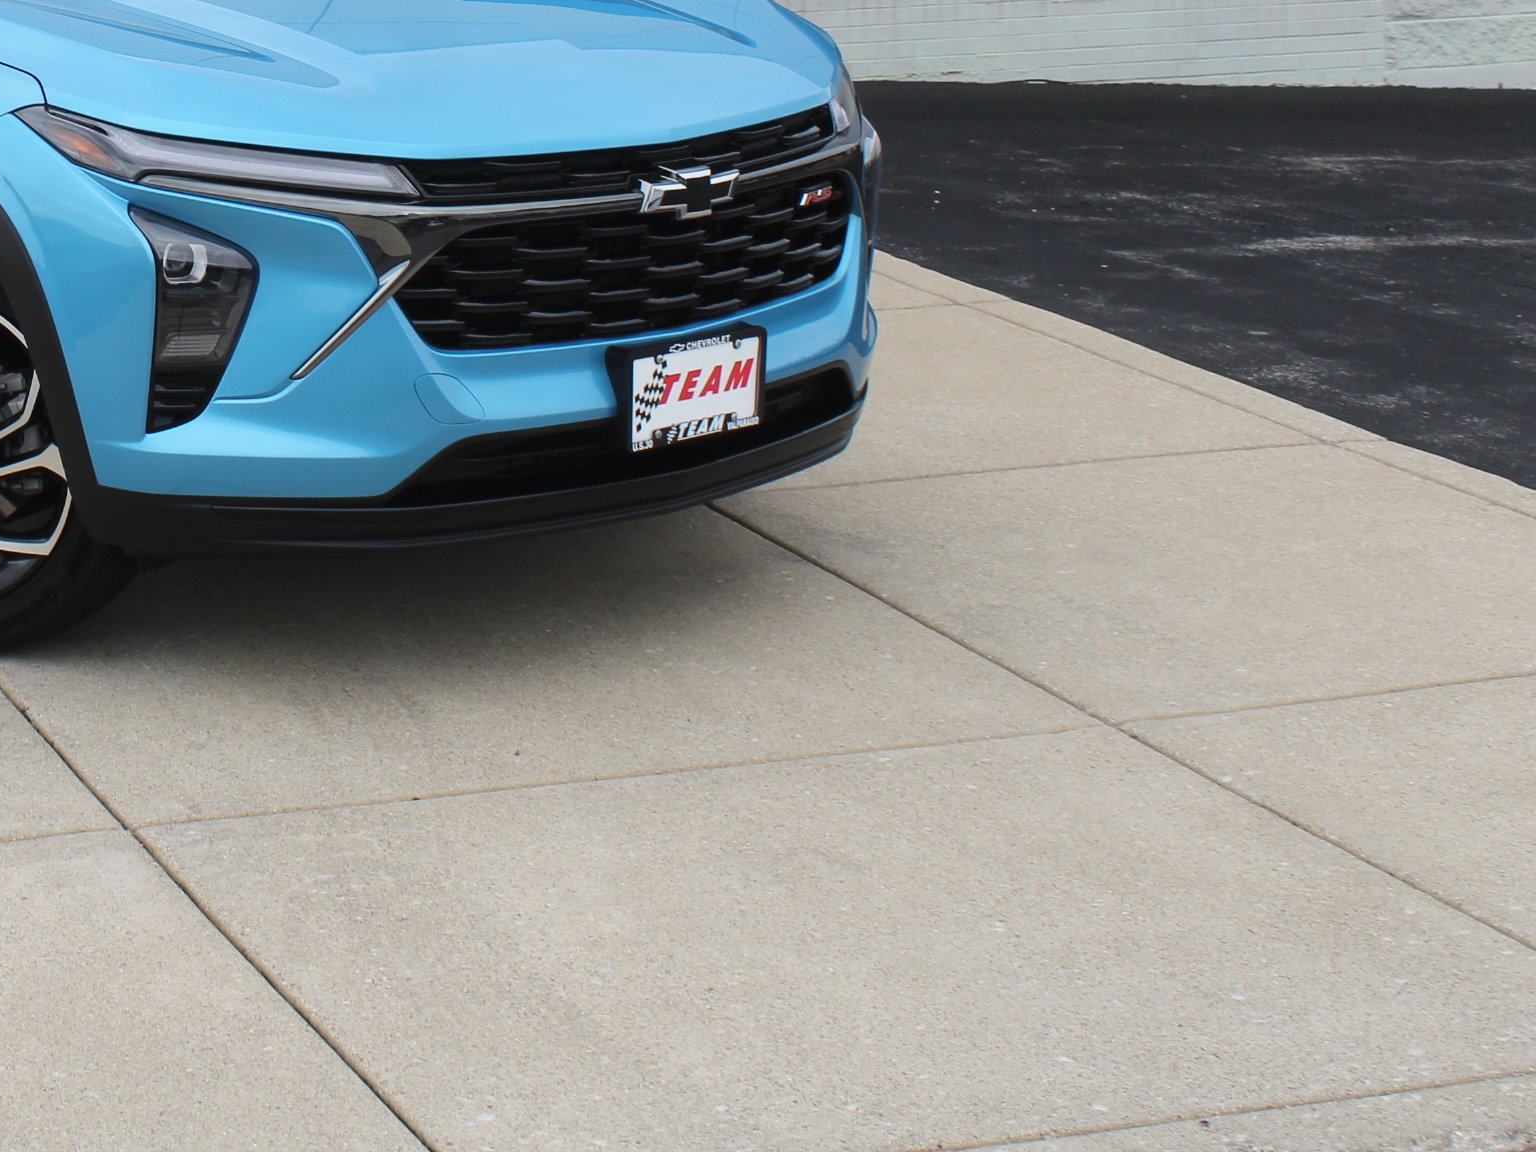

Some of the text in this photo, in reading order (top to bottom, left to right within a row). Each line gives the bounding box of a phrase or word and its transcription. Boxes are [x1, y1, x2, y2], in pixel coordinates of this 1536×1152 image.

[800, 185, 833, 206] RS
[686, 334, 731, 350] CHEVROLET
[659, 357, 754, 405] TEAM
[677, 414, 725, 440] TEAM
